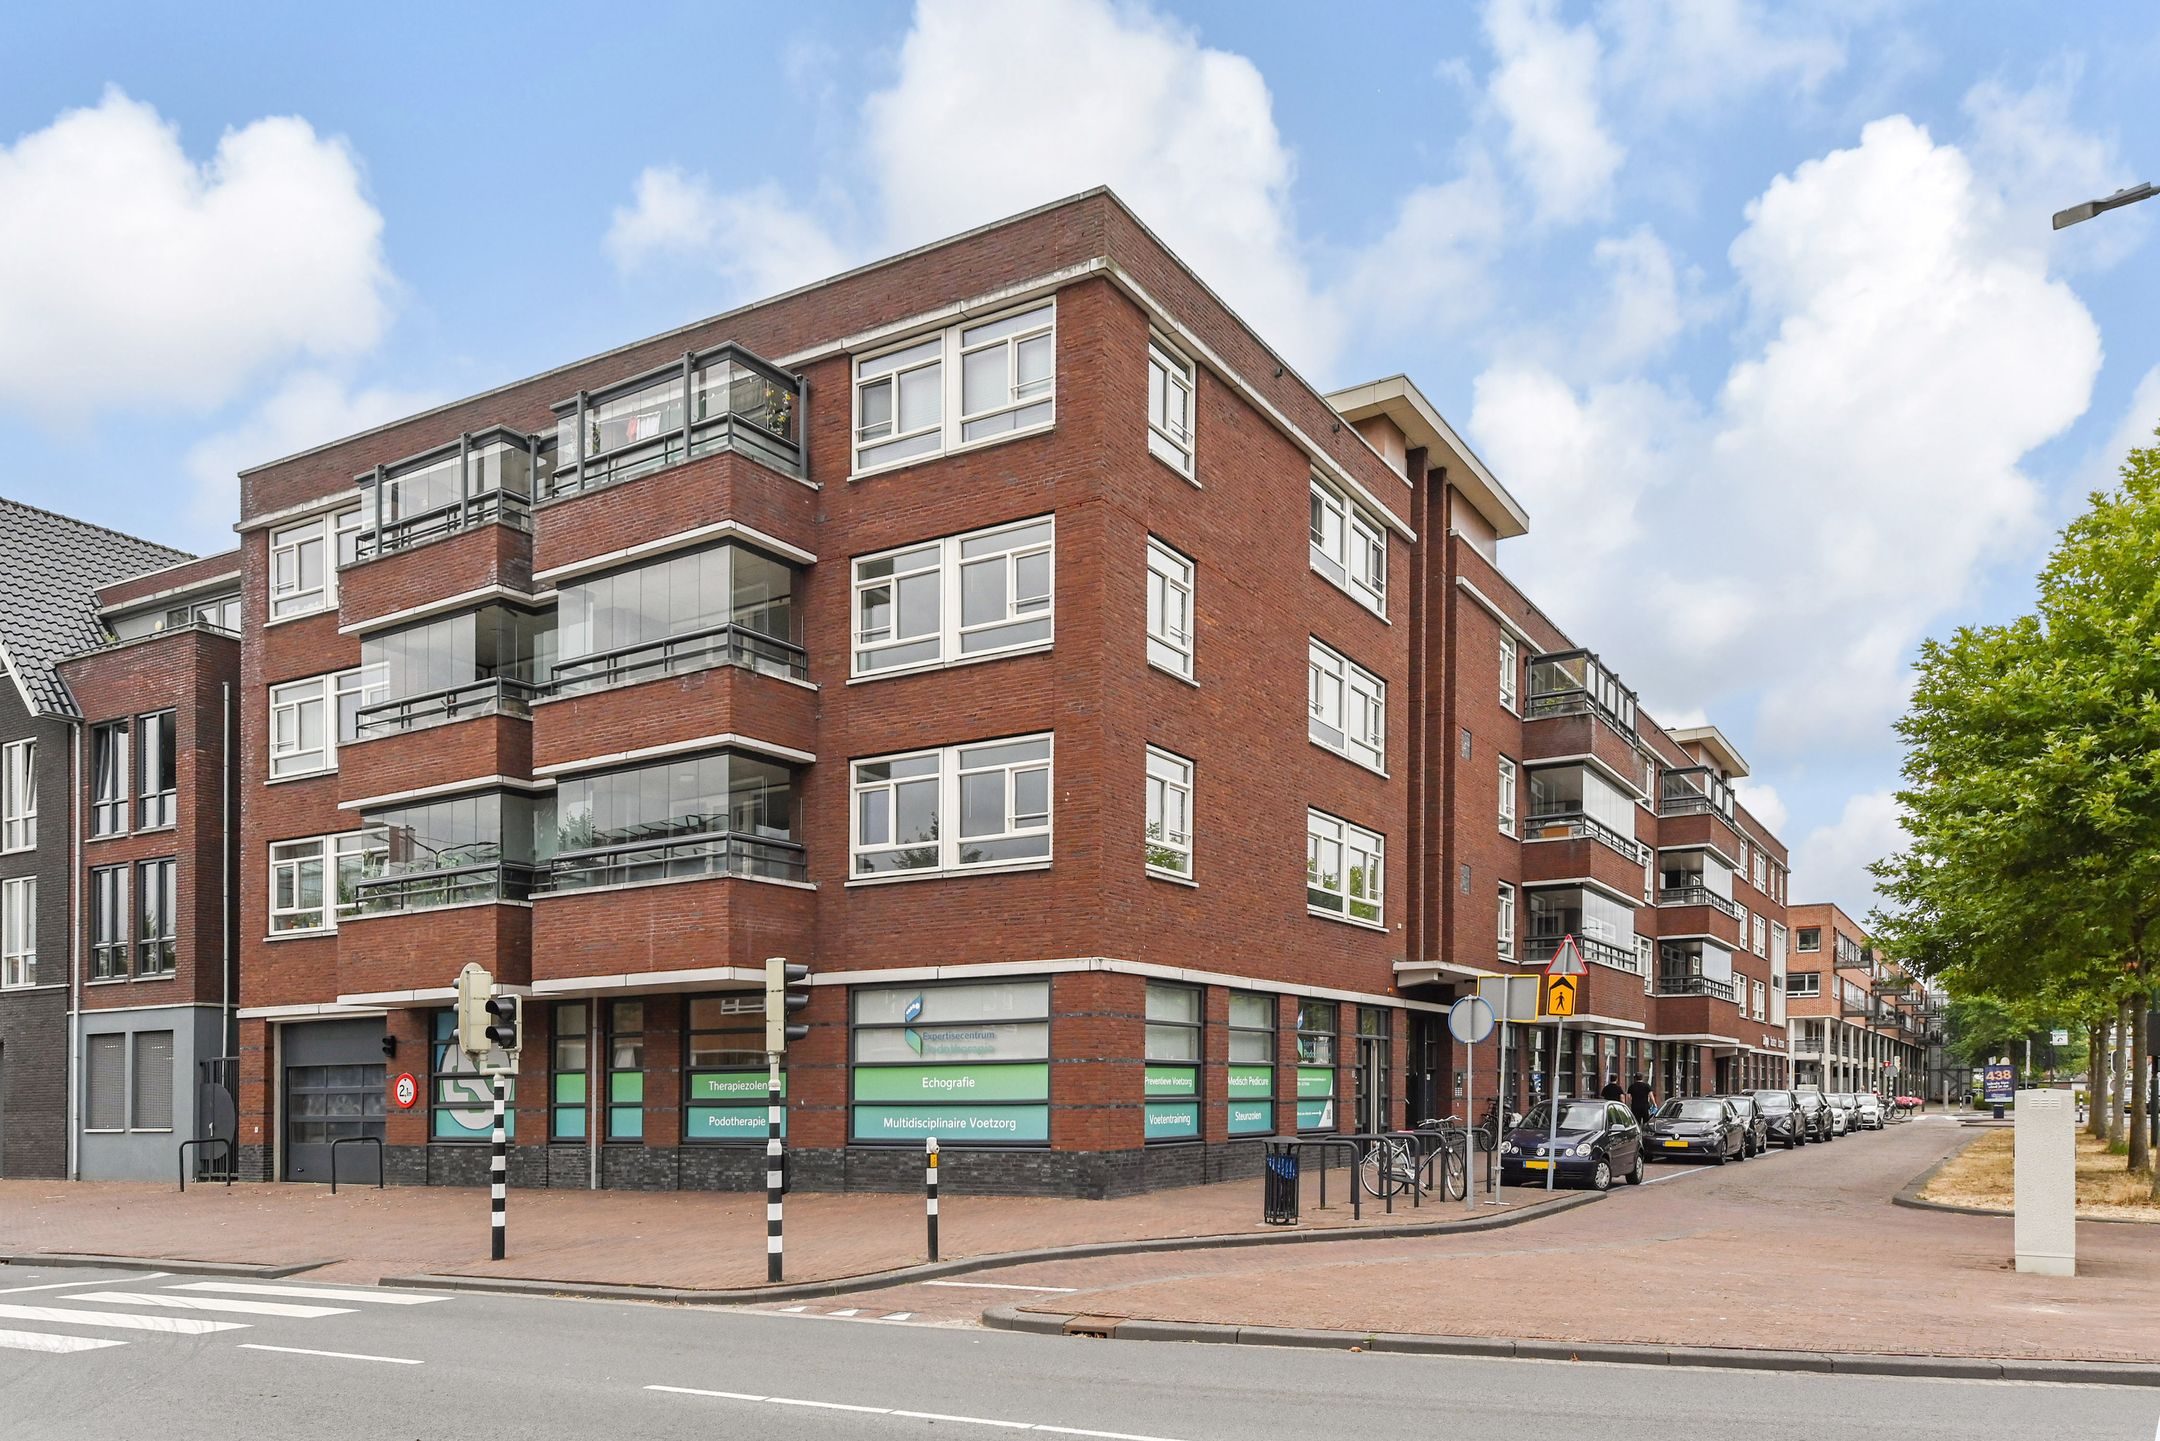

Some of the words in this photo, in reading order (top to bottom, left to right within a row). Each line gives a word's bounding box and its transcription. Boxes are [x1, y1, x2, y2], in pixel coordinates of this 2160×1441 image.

[922, 1032, 995, 1041] Expertisecentrum
[1248, 1076, 1269, 1086] Pedicure
[1986, 1069, 2012, 1081] 438
[708, 1080, 768, 1092] Therapiezolen
[922, 1077, 975, 1090] Echografie
[1172, 1076, 1192, 1088] Voetzorg
[708, 1116, 766, 1128] Podotherapie
[883, 1117, 966, 1130] Multidisciplinaire
[969, 1117, 1017, 1131] Voetzorg
[1149, 1113, 1191, 1126] Voetentraining
